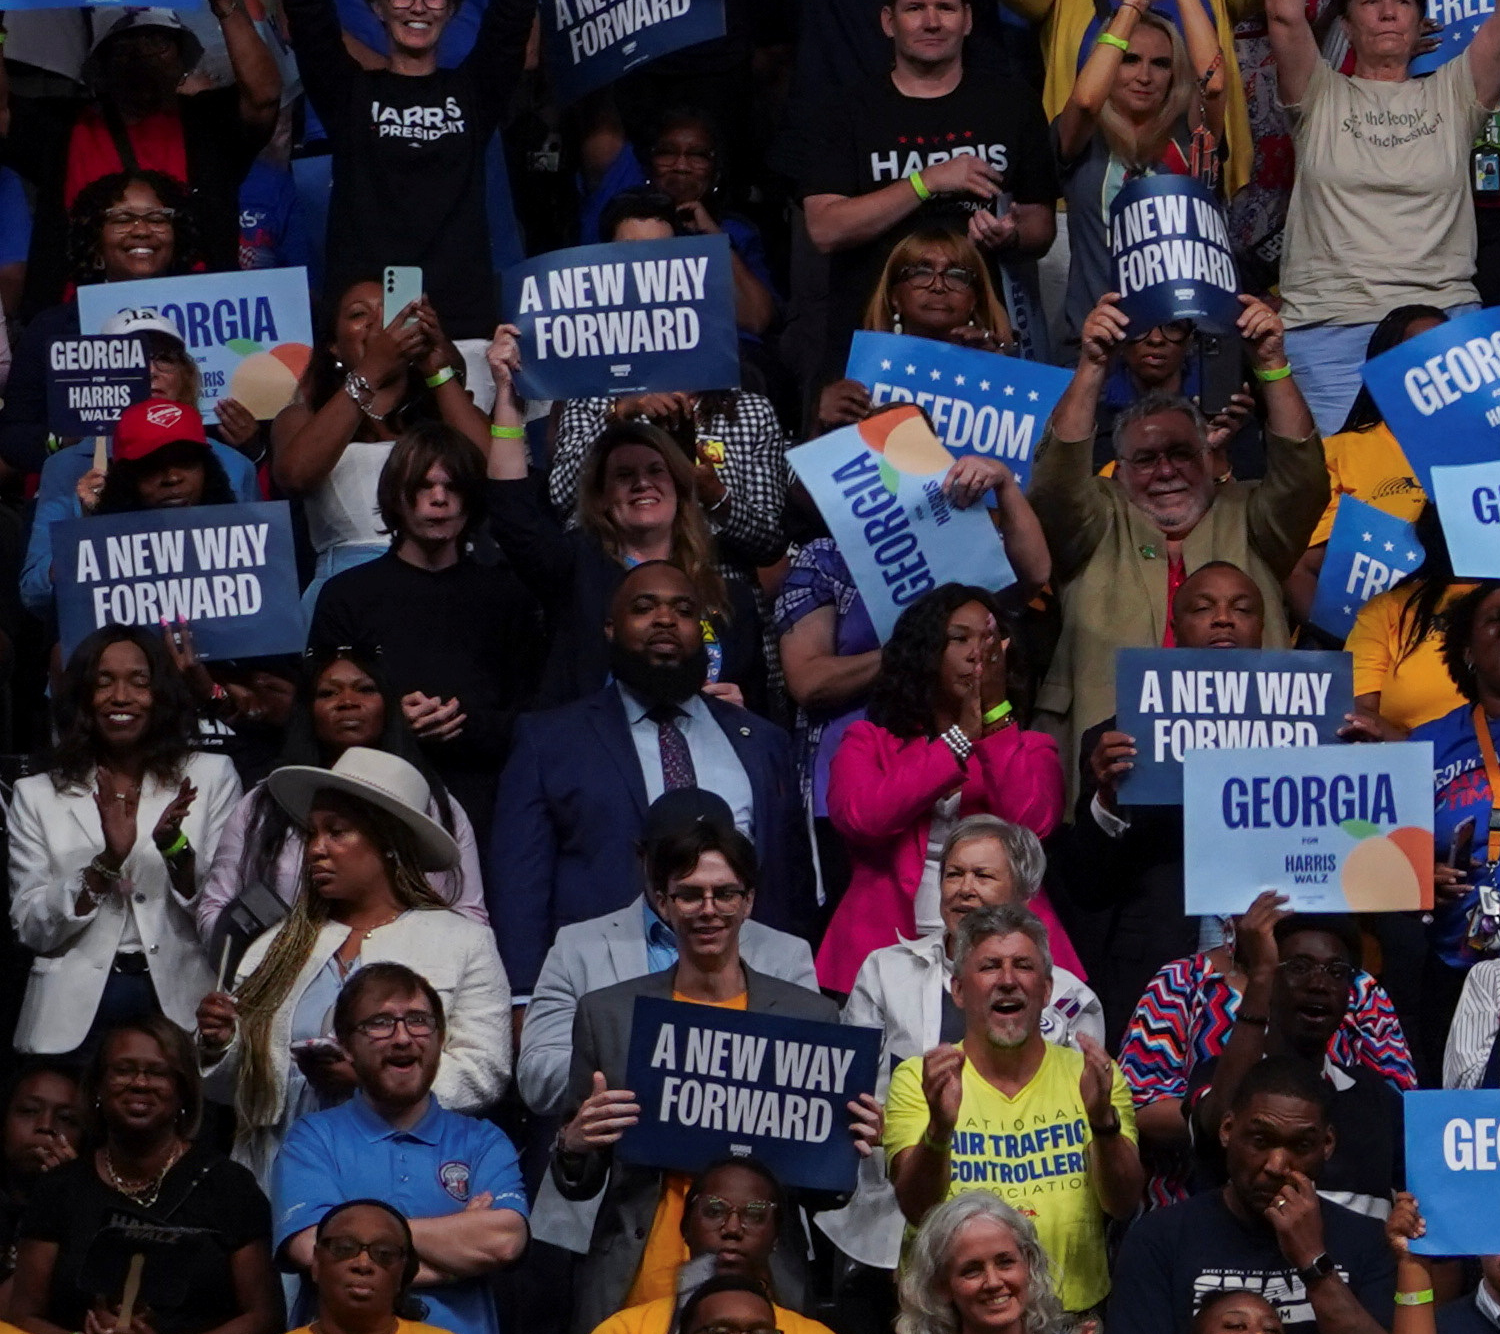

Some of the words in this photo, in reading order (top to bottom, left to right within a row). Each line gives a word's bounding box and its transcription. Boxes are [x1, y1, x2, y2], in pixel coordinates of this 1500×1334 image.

[519, 272, 541, 314] A
[547, 265, 625, 312] NEW
[632, 257, 707, 305] WAY
[536, 307, 701, 359] FORWARD
[51, 340, 145, 370] GEORGIA
[68, 385, 131, 409] HARRIS
[77, 539, 99, 581] A
[106, 532, 184, 579] NEW
[191, 525, 269, 572] WAY
[95, 575, 262, 628] FORWARD
[1222, 772, 1396, 828] GEORGIA
[1285, 853, 1336, 872] HARRIS
[1295, 872, 1327, 883] WALZ
[989, 1121, 1086, 1152] TRAFFIC
